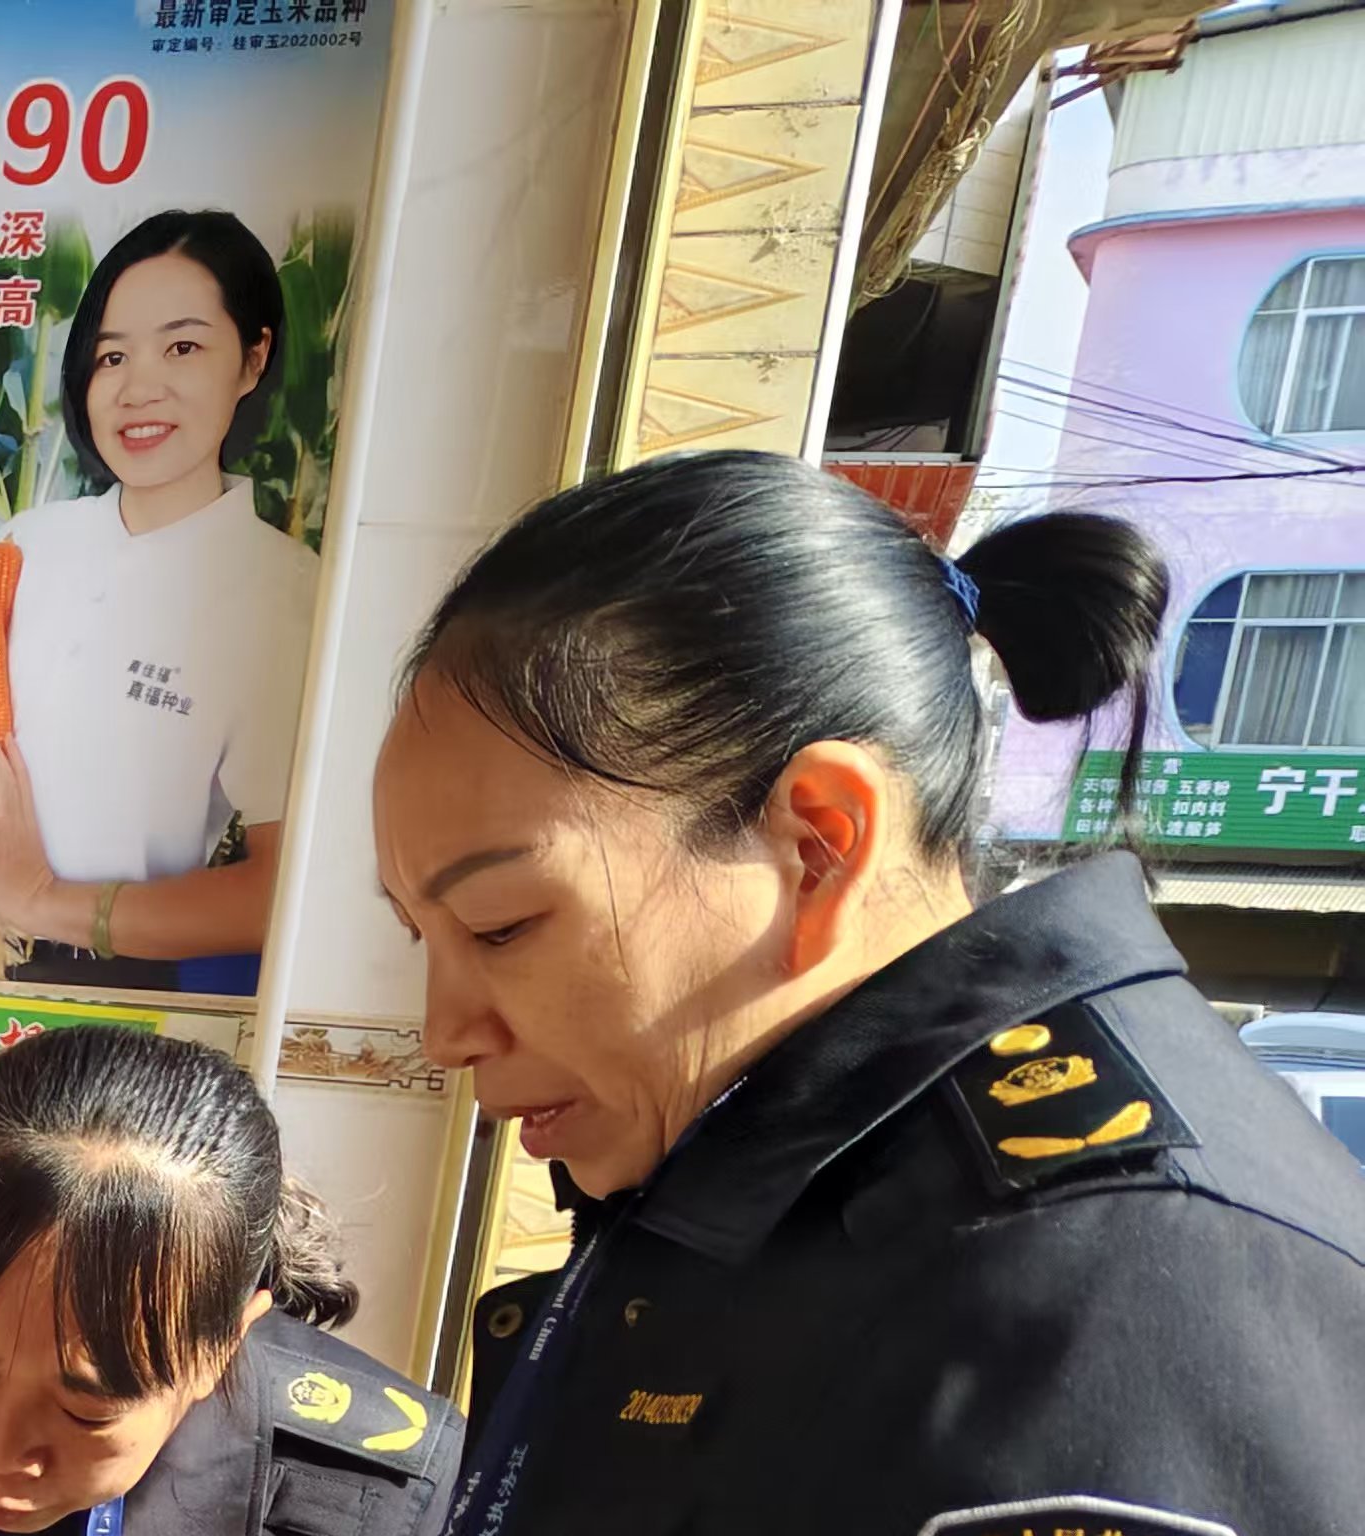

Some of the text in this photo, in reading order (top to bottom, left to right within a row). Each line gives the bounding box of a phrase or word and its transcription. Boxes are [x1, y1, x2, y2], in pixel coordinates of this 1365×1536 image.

[154, 0, 366, 28] 最新审定玉米品种
[126, 680, 192, 716] 真福种业
[1257, 766, 1365, 816] 宁干
